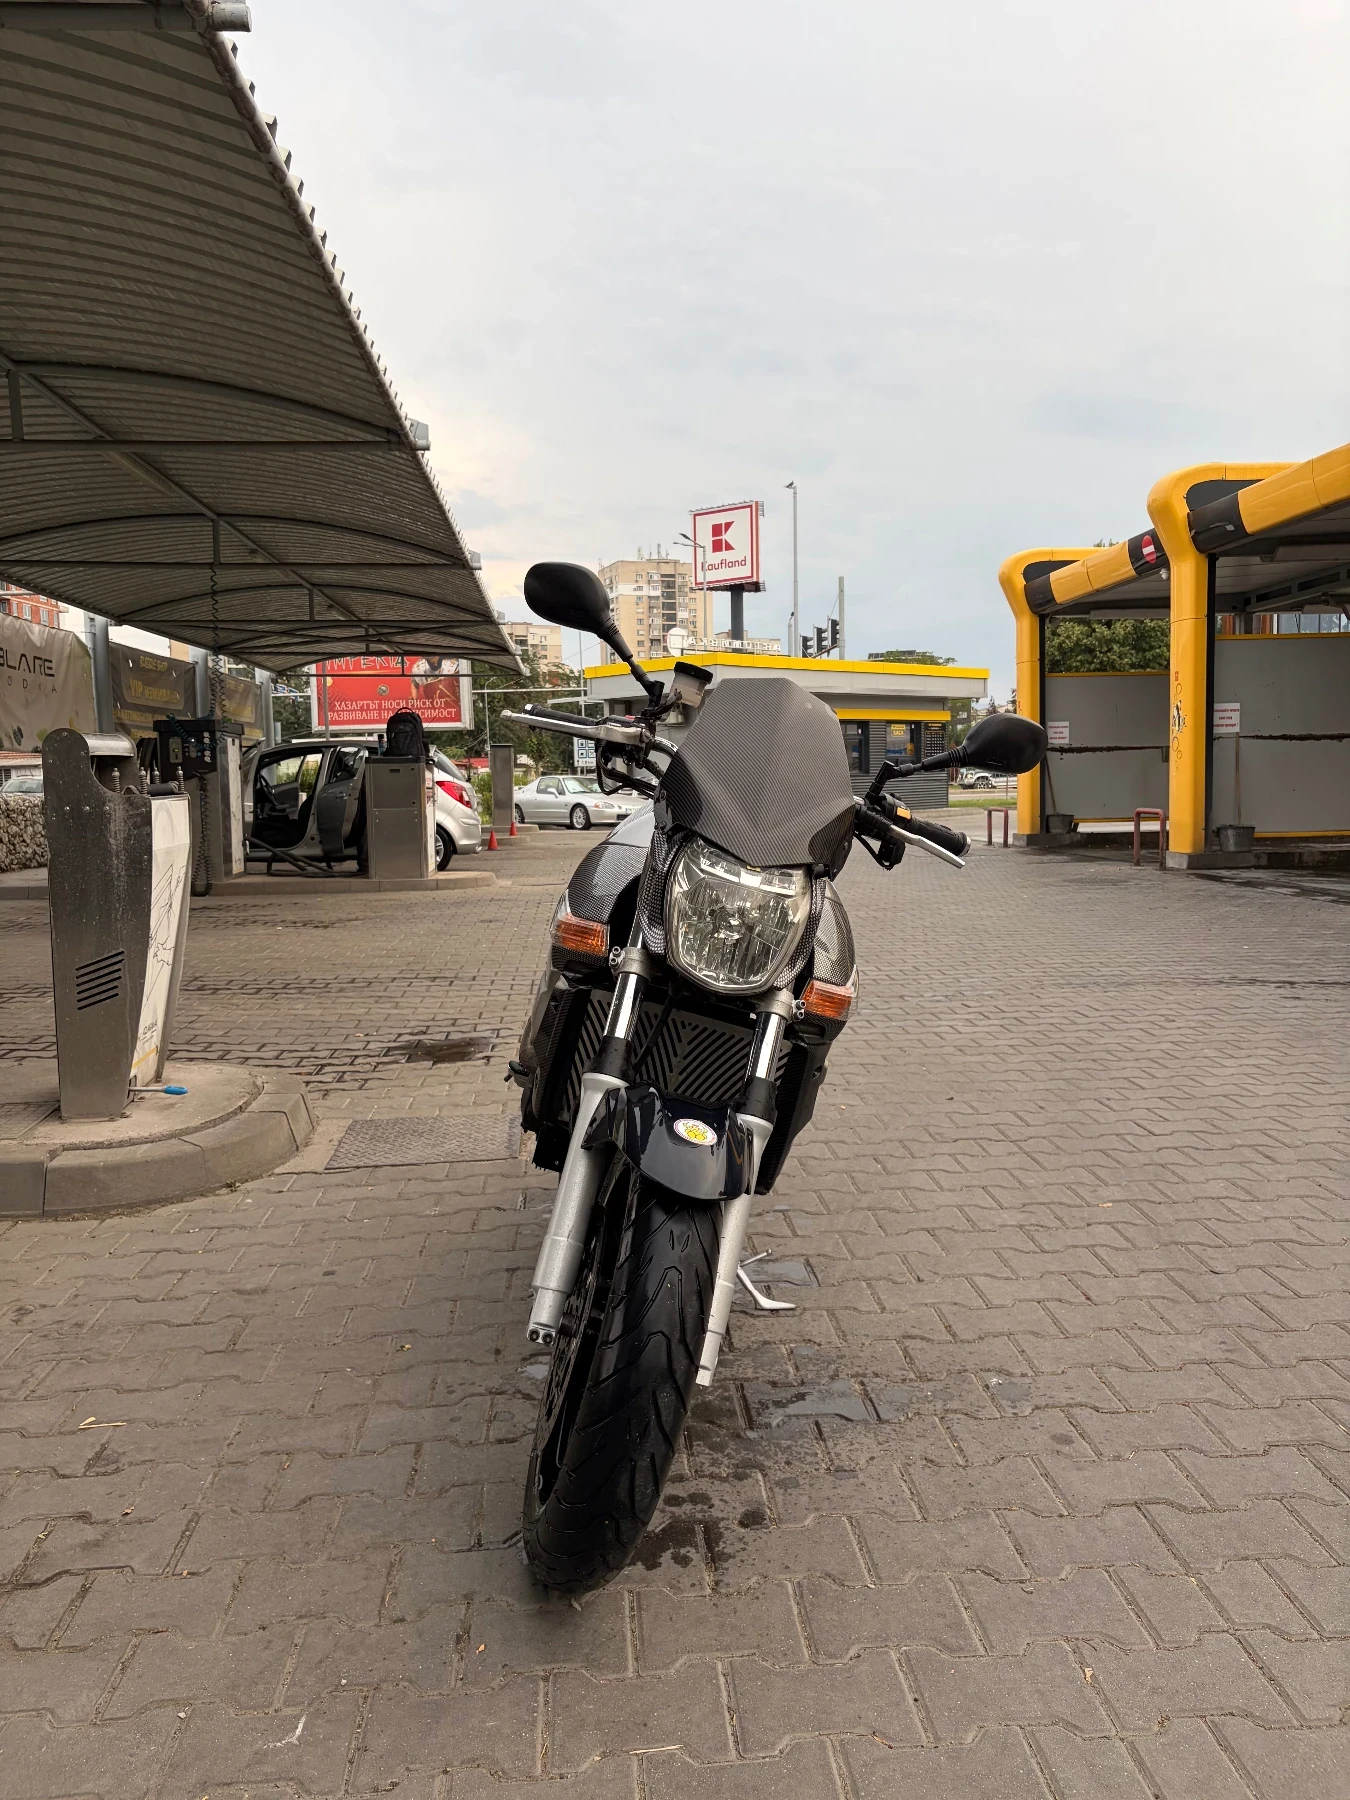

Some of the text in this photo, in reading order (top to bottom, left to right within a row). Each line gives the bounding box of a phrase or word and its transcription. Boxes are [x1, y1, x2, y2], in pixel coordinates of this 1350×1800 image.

[335, 698, 446, 711] ХАЗАРТЪТ НОСИ РИСК ОТ
[328, 710, 380, 721] РАЗВИВАНЕ
[398, 708, 457, 718] ИСИМОСТ
